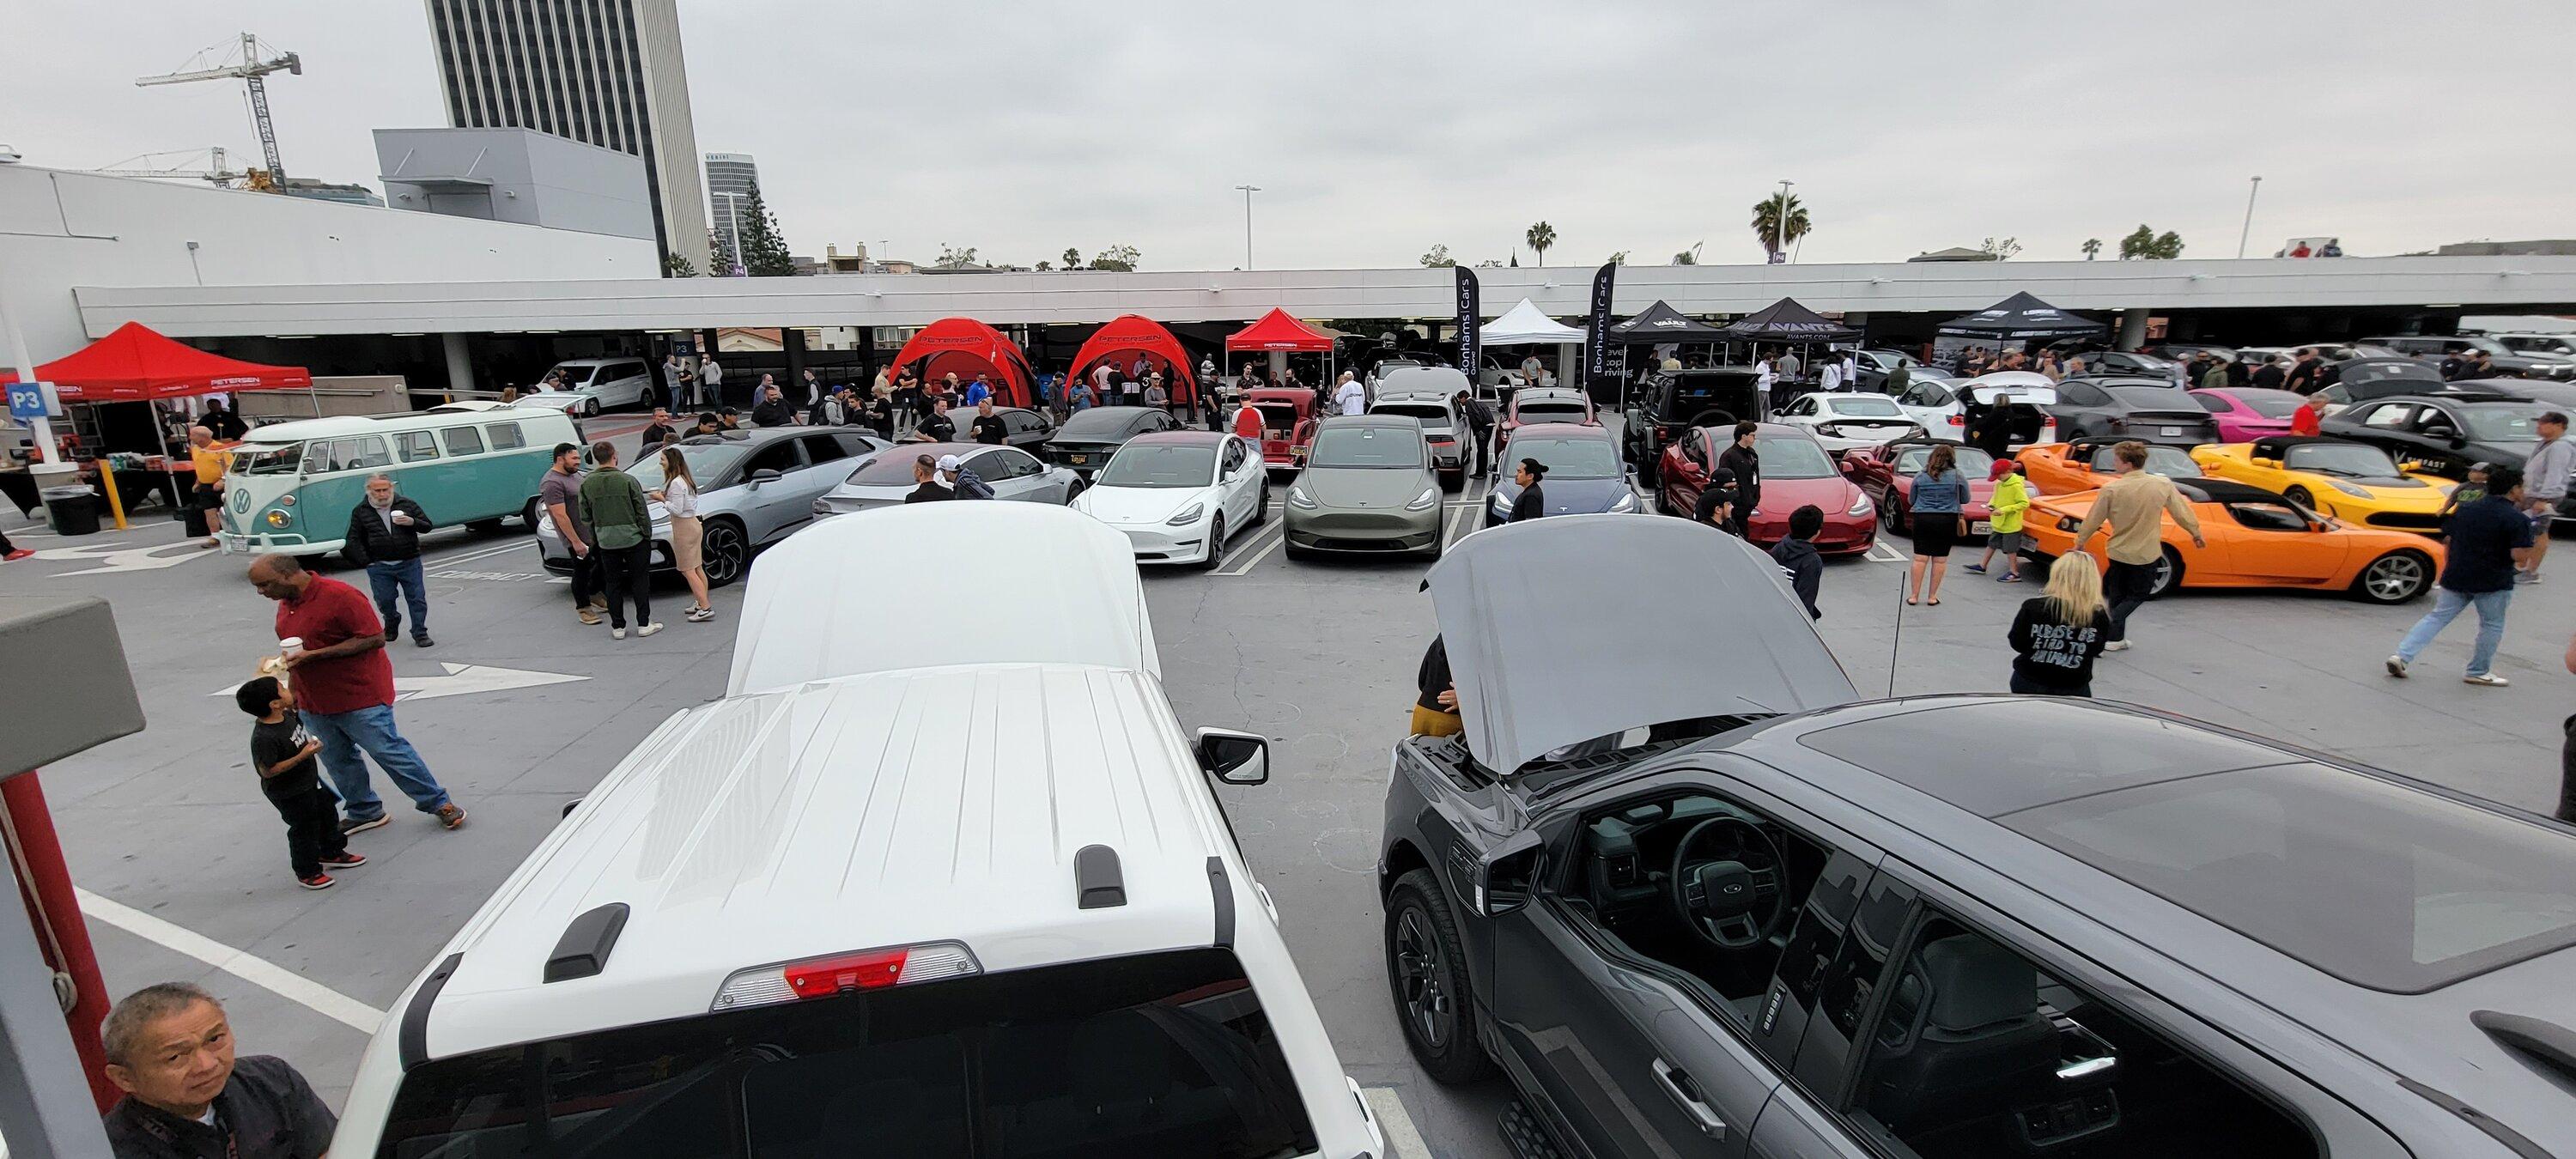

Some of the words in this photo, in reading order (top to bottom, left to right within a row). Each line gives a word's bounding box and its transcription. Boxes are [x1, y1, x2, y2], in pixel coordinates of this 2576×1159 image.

[1461, 278, 1469, 309] Cars
[1598, 276, 1607, 306] Cars
[1769, 322, 1838, 331] AVANTS
[919, 336, 983, 344] PETERSEN
[1461, 314, 1470, 376] Bonhams
[1594, 313, 1605, 373] Bonhams
[210, 378, 260, 386] PETERSEN
[11, 391, 40, 409] P3
[234, 488, 251, 514] VW
[2030, 623, 2075, 640] PLEASE
[2078, 627, 2098, 642] BE
[2032, 637, 2065, 650] KIND
[2069, 641, 2087, 654] TO
[2030, 650, 2084, 669] ANIMALS
